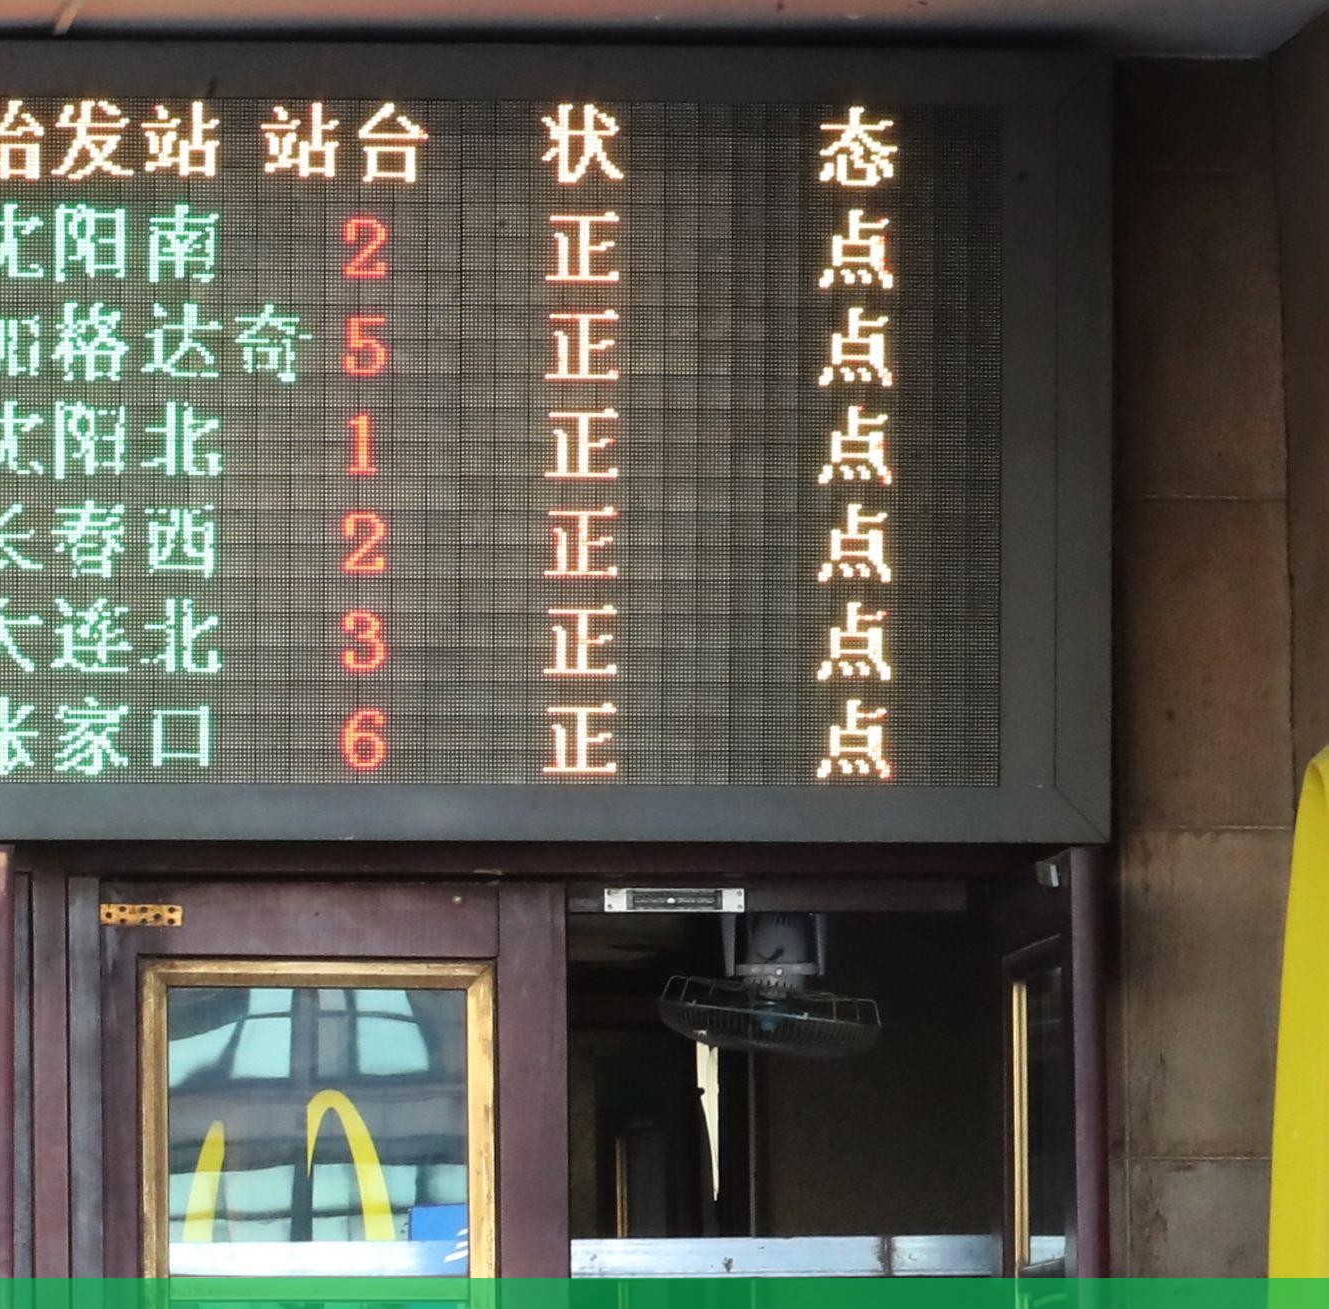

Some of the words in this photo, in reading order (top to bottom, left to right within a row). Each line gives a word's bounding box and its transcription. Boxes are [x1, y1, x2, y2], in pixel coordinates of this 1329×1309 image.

[260, 102, 429, 184] 站台
[342, 215, 391, 281] 2
[341, 314, 391, 380] 5
[345, 412, 380, 479] 1
[340, 510, 390, 577] 2
[340, 608, 390, 675] 3
[340, 707, 390, 773] 6
